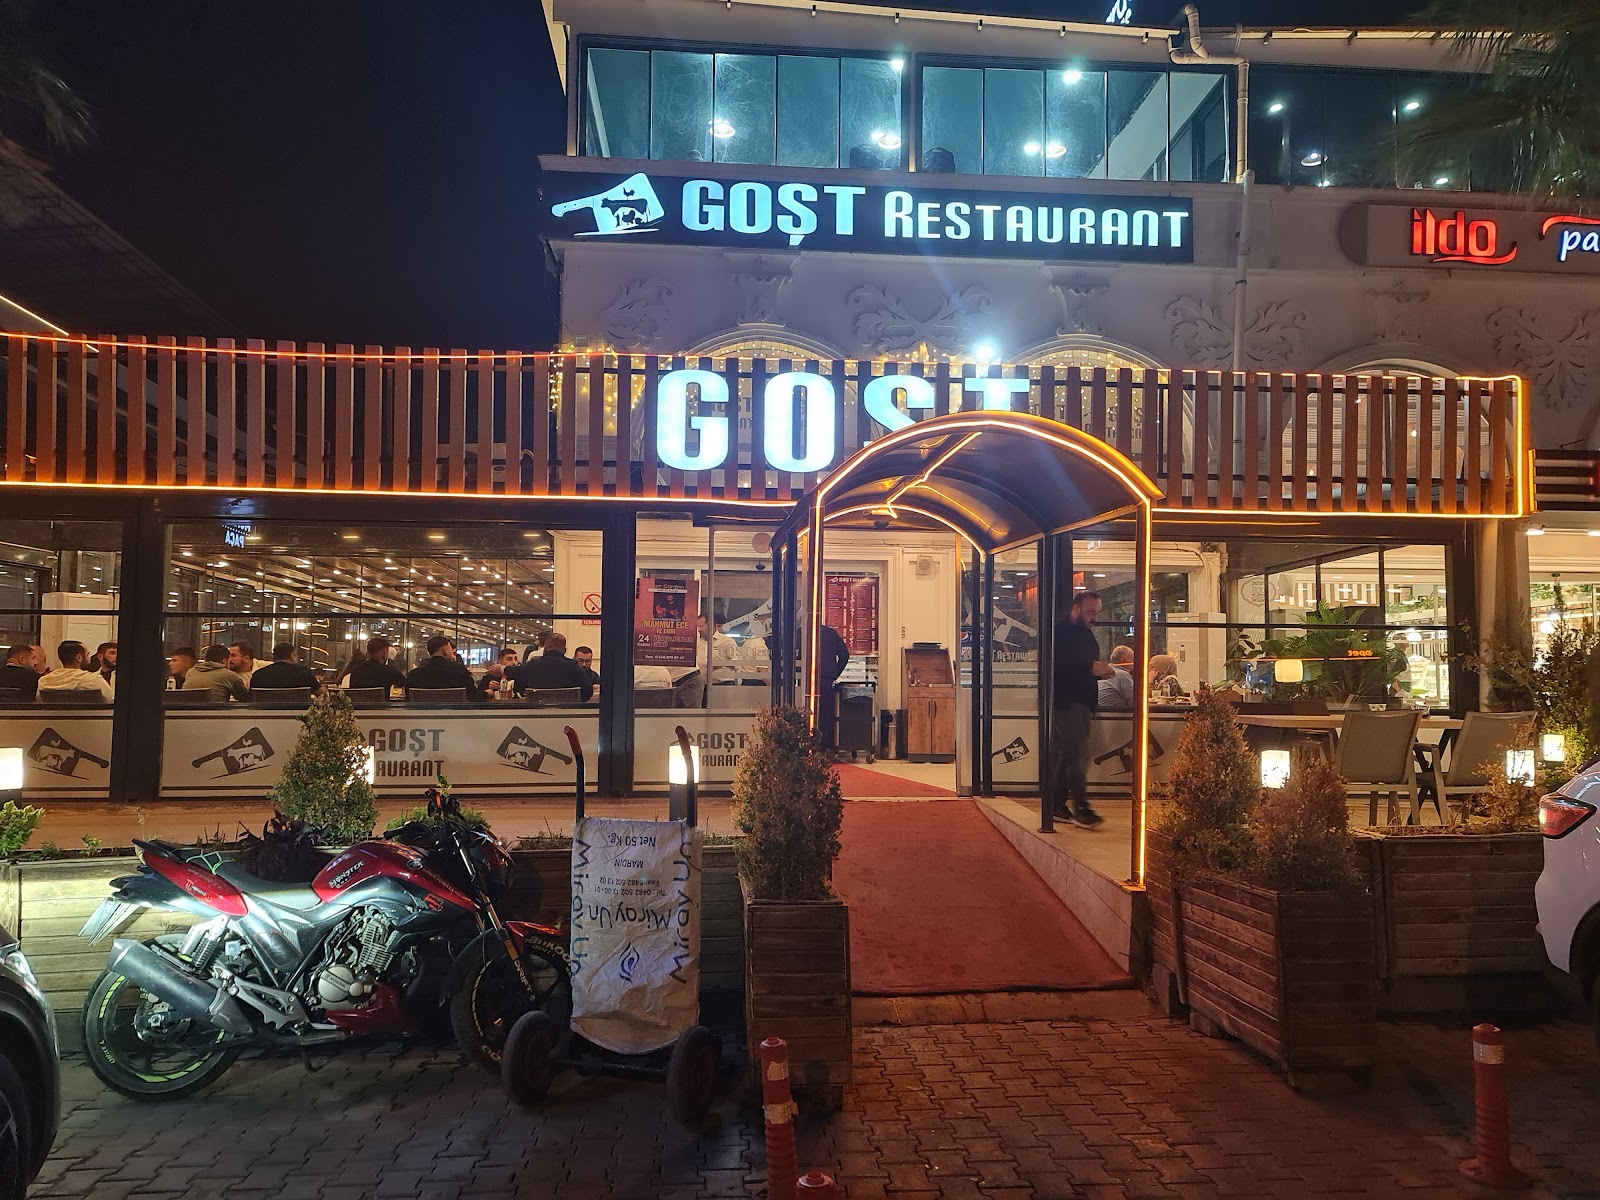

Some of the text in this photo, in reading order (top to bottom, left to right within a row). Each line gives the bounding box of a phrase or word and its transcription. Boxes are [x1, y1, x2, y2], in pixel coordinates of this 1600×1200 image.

[682, 179, 866, 246] GOŞT
[1412, 208, 1497, 257] ildo
[643, 620, 689, 629] MAHMUT ECE
[638, 634, 649, 642] 24
[368, 729, 445, 757] GOŞT
[697, 733, 748, 752] GOŞT
[625, 836, 637, 846] 50
[640, 836, 656, 847] Net
[599, 876, 606, 884] 02
[607, 877, 614, 885] 13
[620, 888, 632, 896] 502
[588, 901, 672, 930] Miray Un
[669, 889, 693, 984] Miray
